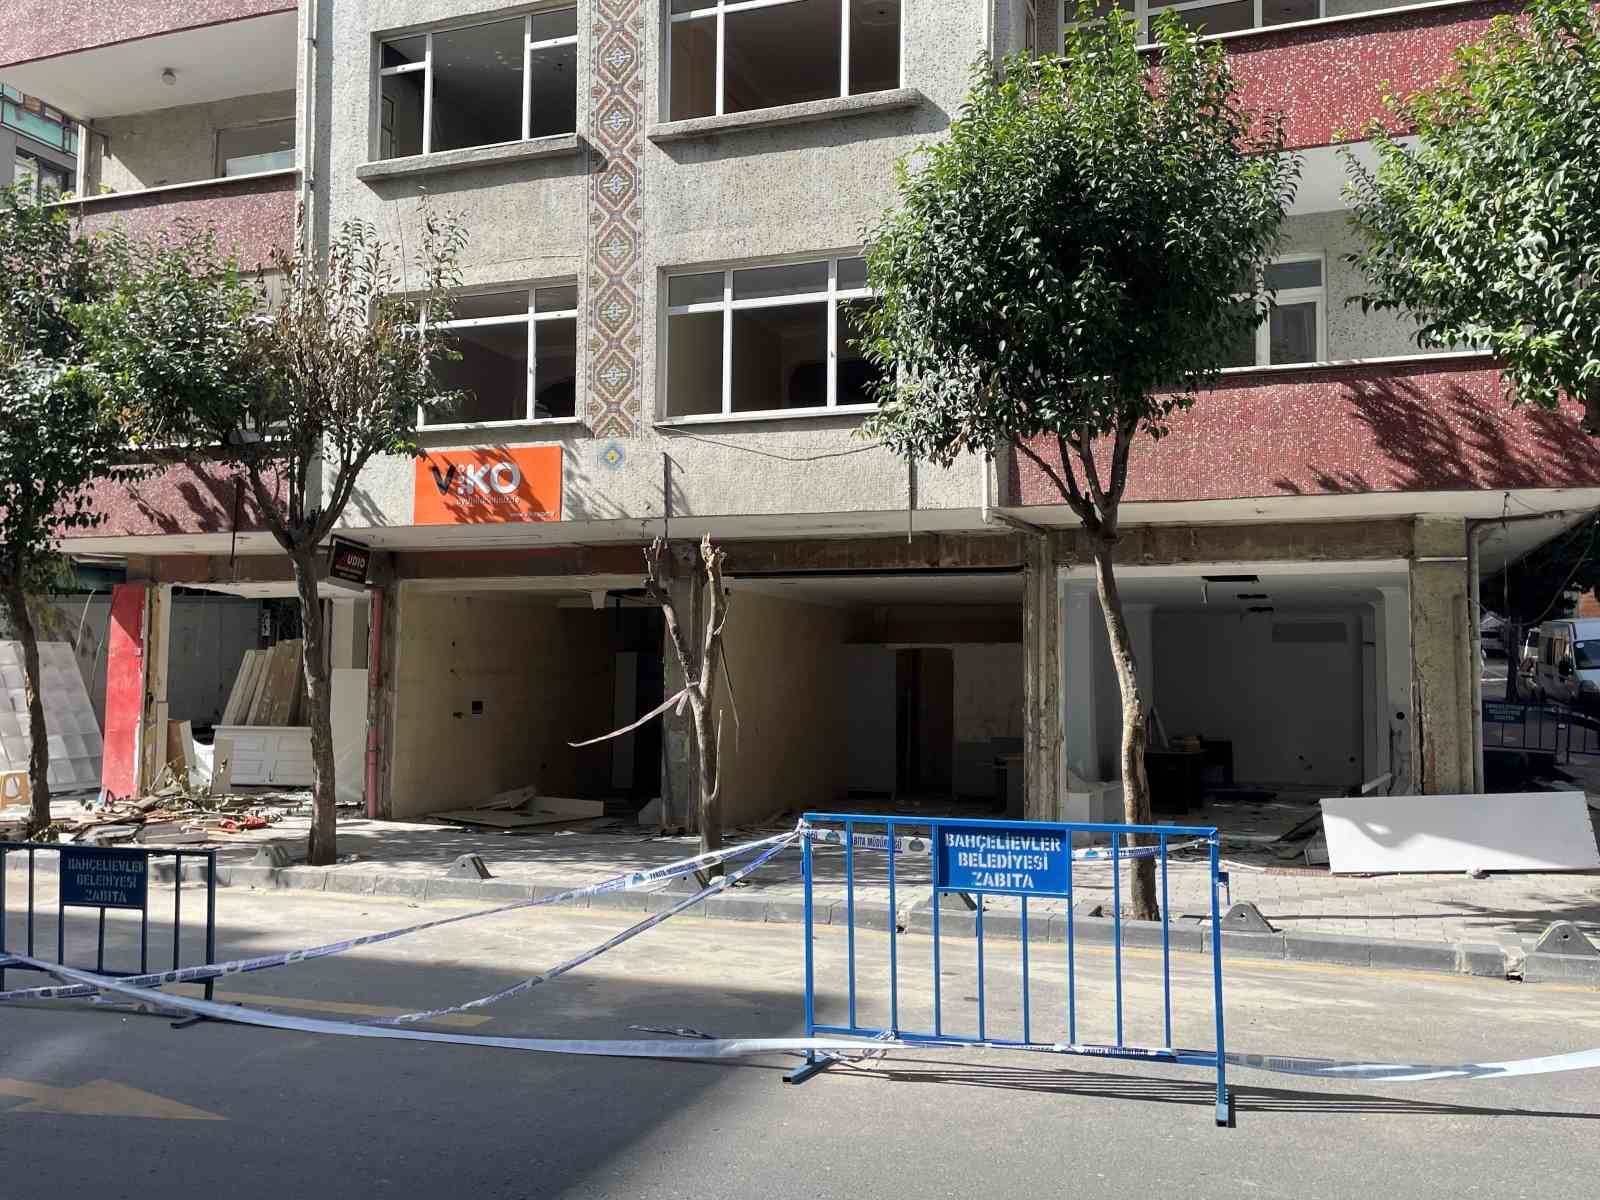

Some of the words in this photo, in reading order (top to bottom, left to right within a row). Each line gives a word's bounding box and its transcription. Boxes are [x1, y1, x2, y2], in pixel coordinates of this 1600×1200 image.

[945, 832, 1061, 852] BAHÇELİEVLER
[958, 851, 1048, 870] BELEDİYESİ
[972, 871, 1034, 888] ZABITA
